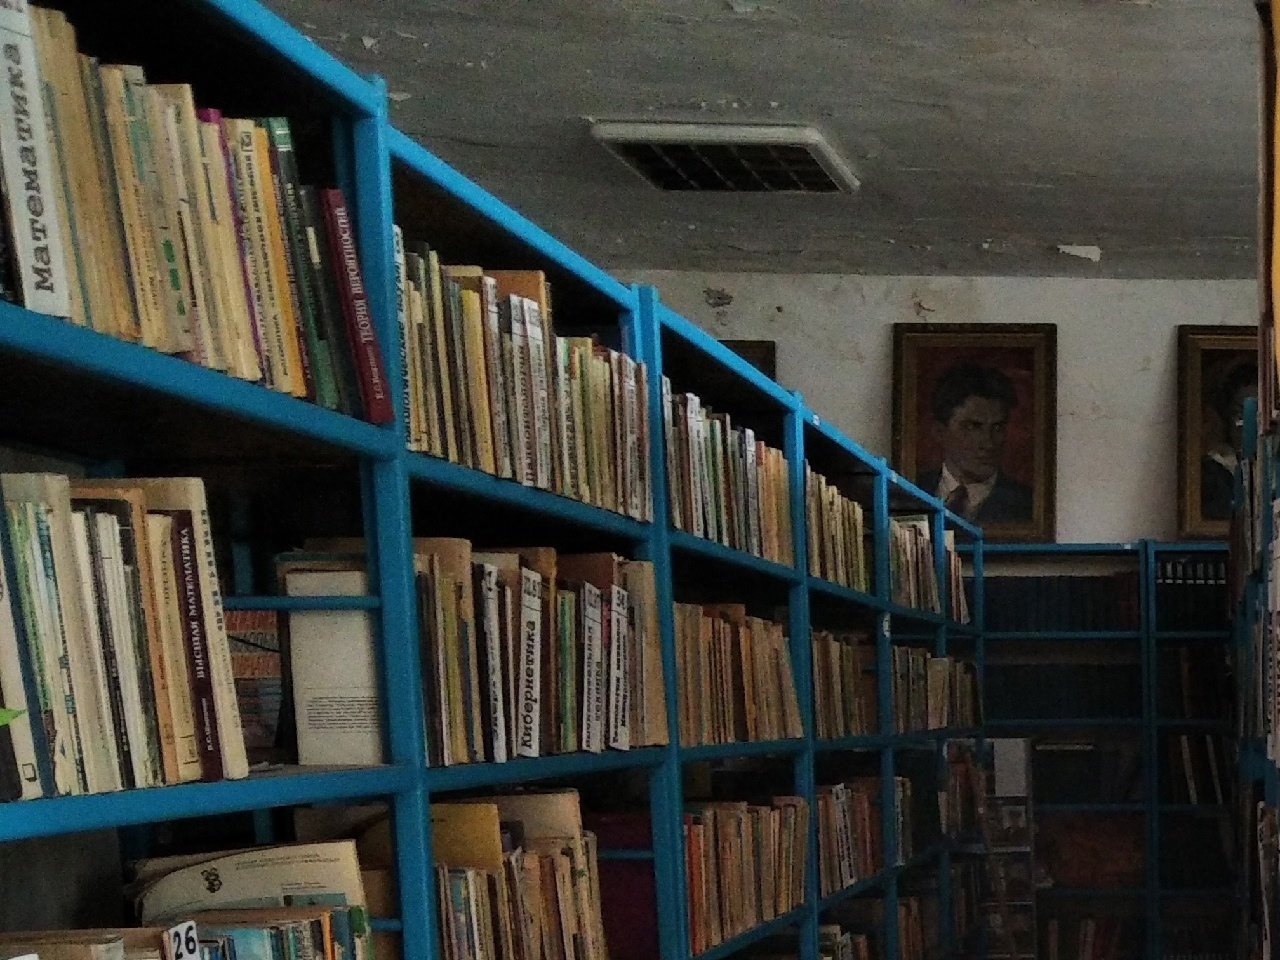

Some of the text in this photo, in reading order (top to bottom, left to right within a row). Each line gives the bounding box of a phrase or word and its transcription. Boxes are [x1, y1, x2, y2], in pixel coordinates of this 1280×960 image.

[3, 43, 55, 294] Математика
[334, 207, 364, 294] ВЕРОЯТНОСТЕЙ
[353, 299, 374, 342] ТЕОРИЯ
[179, 527, 198, 616] МАТЕМАТИКА
[521, 621, 537, 749] Кибернетика
[173, 925, 197, 960] 26
